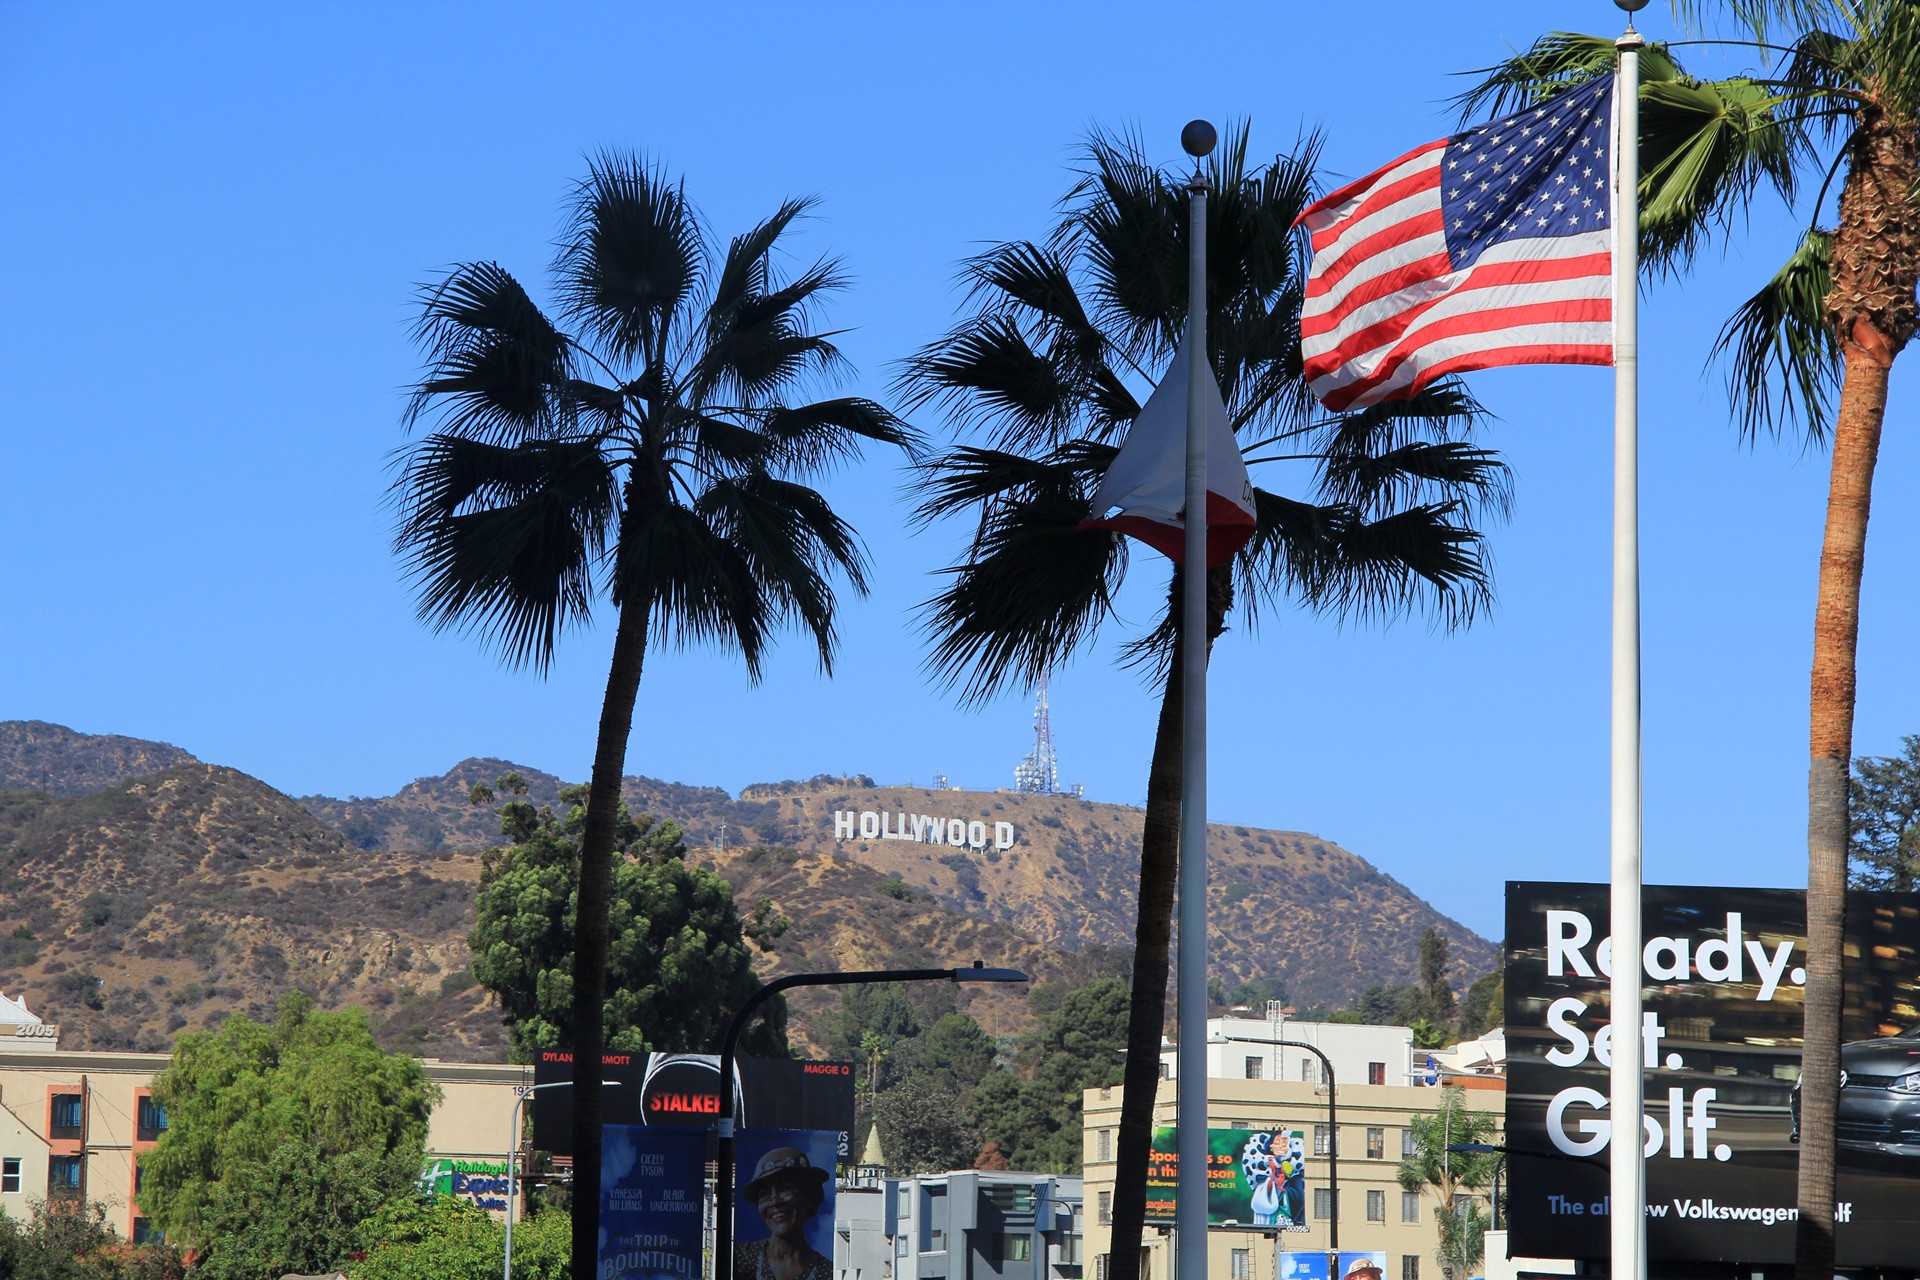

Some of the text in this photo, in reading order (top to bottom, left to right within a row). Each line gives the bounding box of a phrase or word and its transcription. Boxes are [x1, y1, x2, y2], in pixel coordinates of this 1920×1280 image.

[835, 810, 1014, 849] HOLLYWOOD
[16, 1024, 55, 1037] 2005
[543, 1052, 573, 1063] DYLAN
[804, 1065, 850, 1075] MAGGIE Q
[641, 1154, 665, 1165] CICELY
[1217, 1154, 1233, 1164] so
[454, 1159, 499, 1176] Holiday
[641, 1165, 664, 1177] TYSON
[1161, 1163, 1177, 1177] thi
[610, 1189, 642, 1200] VANESSA
[663, 1189, 685, 1200] BLAIR
[609, 1200, 643, 1211] WILLIAMS
[650, 1201, 697, 1213] UNDERWOOD
[1548, 1195, 1583, 1216] The
[1673, 1199, 1798, 1226] Volkswagen
[620, 1234, 679, 1247] THE TRIP TO
[604, 1251, 693, 1280] BOUNTIFUL
